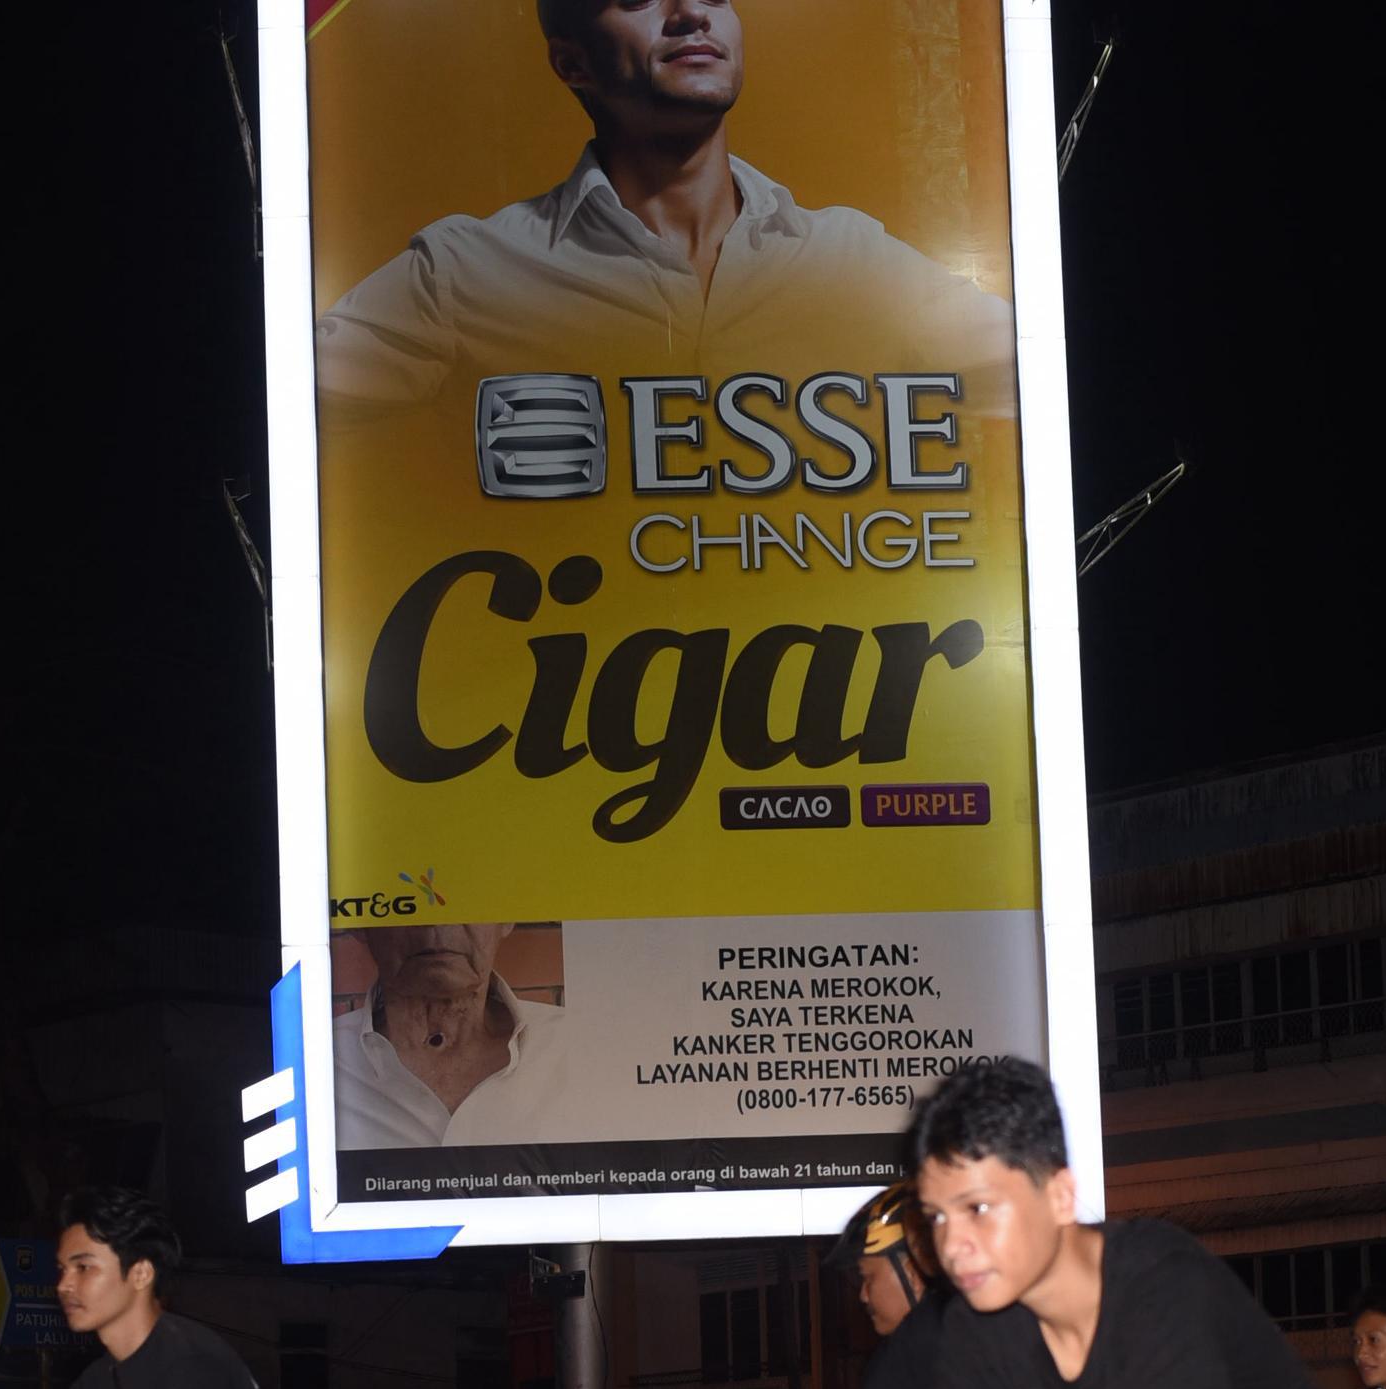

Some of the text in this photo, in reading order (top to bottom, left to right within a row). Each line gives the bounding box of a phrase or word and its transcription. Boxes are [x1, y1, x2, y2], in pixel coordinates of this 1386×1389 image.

[619, 371, 968, 494] ESSE
[628, 509, 977, 573] CHANGE
[363, 550, 986, 844] Cigar
[739, 796, 832, 820] CACAO
[875, 792, 978, 818] PURPLE
[331, 892, 417, 918] KT&G
[718, 944, 919, 970] PERINGATAN:
[702, 976, 942, 1001] KARENA MEROKOK,
[730, 1004, 915, 1028] SAYA TERKENA
[673, 1029, 974, 1056] KANKER TENGGOROKAN
[636, 1061, 749, 1085] LAYANAN
[757, 1057, 879, 1081] BERHENTI
[736, 1085, 914, 1114] (0800-177-6565)
[365, 1177, 431, 1191] Dilarang
[436, 1173, 498, 1190] menjual
[502, 1173, 532, 1186] dan
[536, 1170, 605, 1185] memberi
[609, 1168, 666, 1185] kepada
[670, 1168, 715, 1181] orang
[720, 1166, 734, 1179] di
[739, 1164, 790, 1179] bawah
[794, 1163, 812, 1178] 21
[816, 1162, 861, 1177] tahun
[865, 1161, 895, 1176] dan
